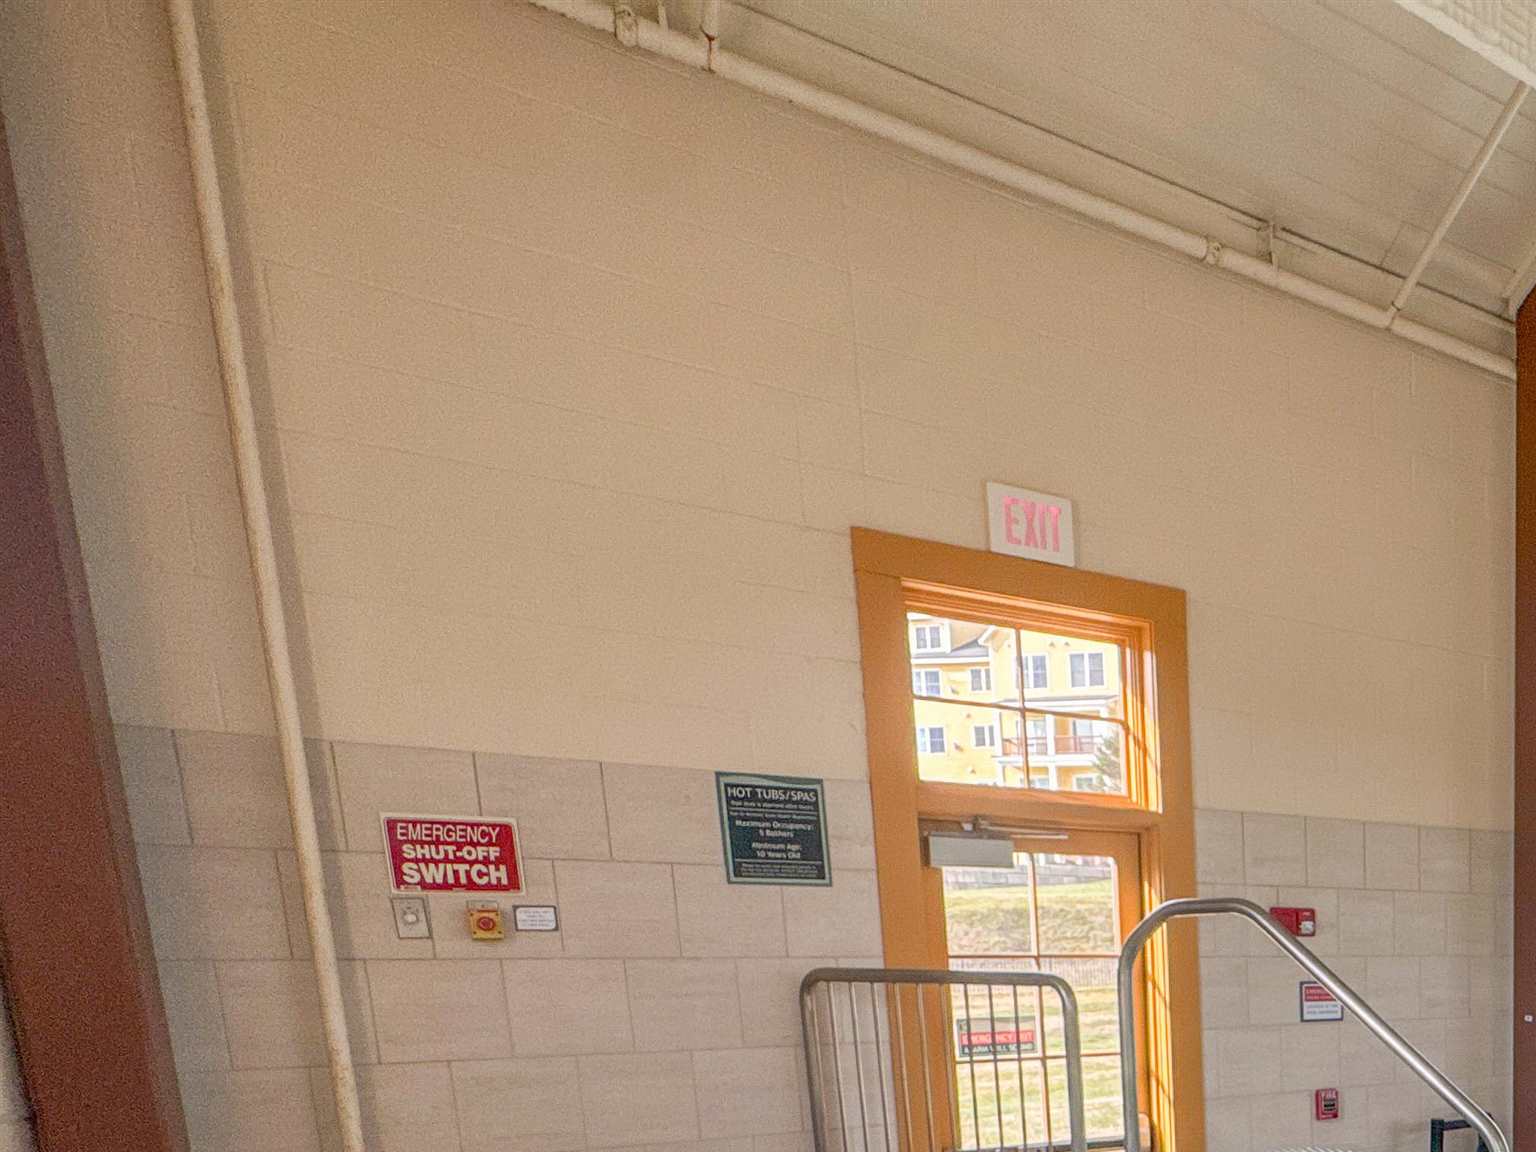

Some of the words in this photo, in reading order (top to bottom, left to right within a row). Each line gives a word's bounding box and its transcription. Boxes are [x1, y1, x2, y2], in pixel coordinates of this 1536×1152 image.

[1003, 496, 1062, 553] EXIT
[727, 787, 753, 799] HOT
[755, 788, 817, 801] TUBS/SPAS
[396, 822, 500, 843] EMERGENCY
[401, 843, 501, 862] SHUT-OFF
[401, 862, 509, 886] SWITCH
